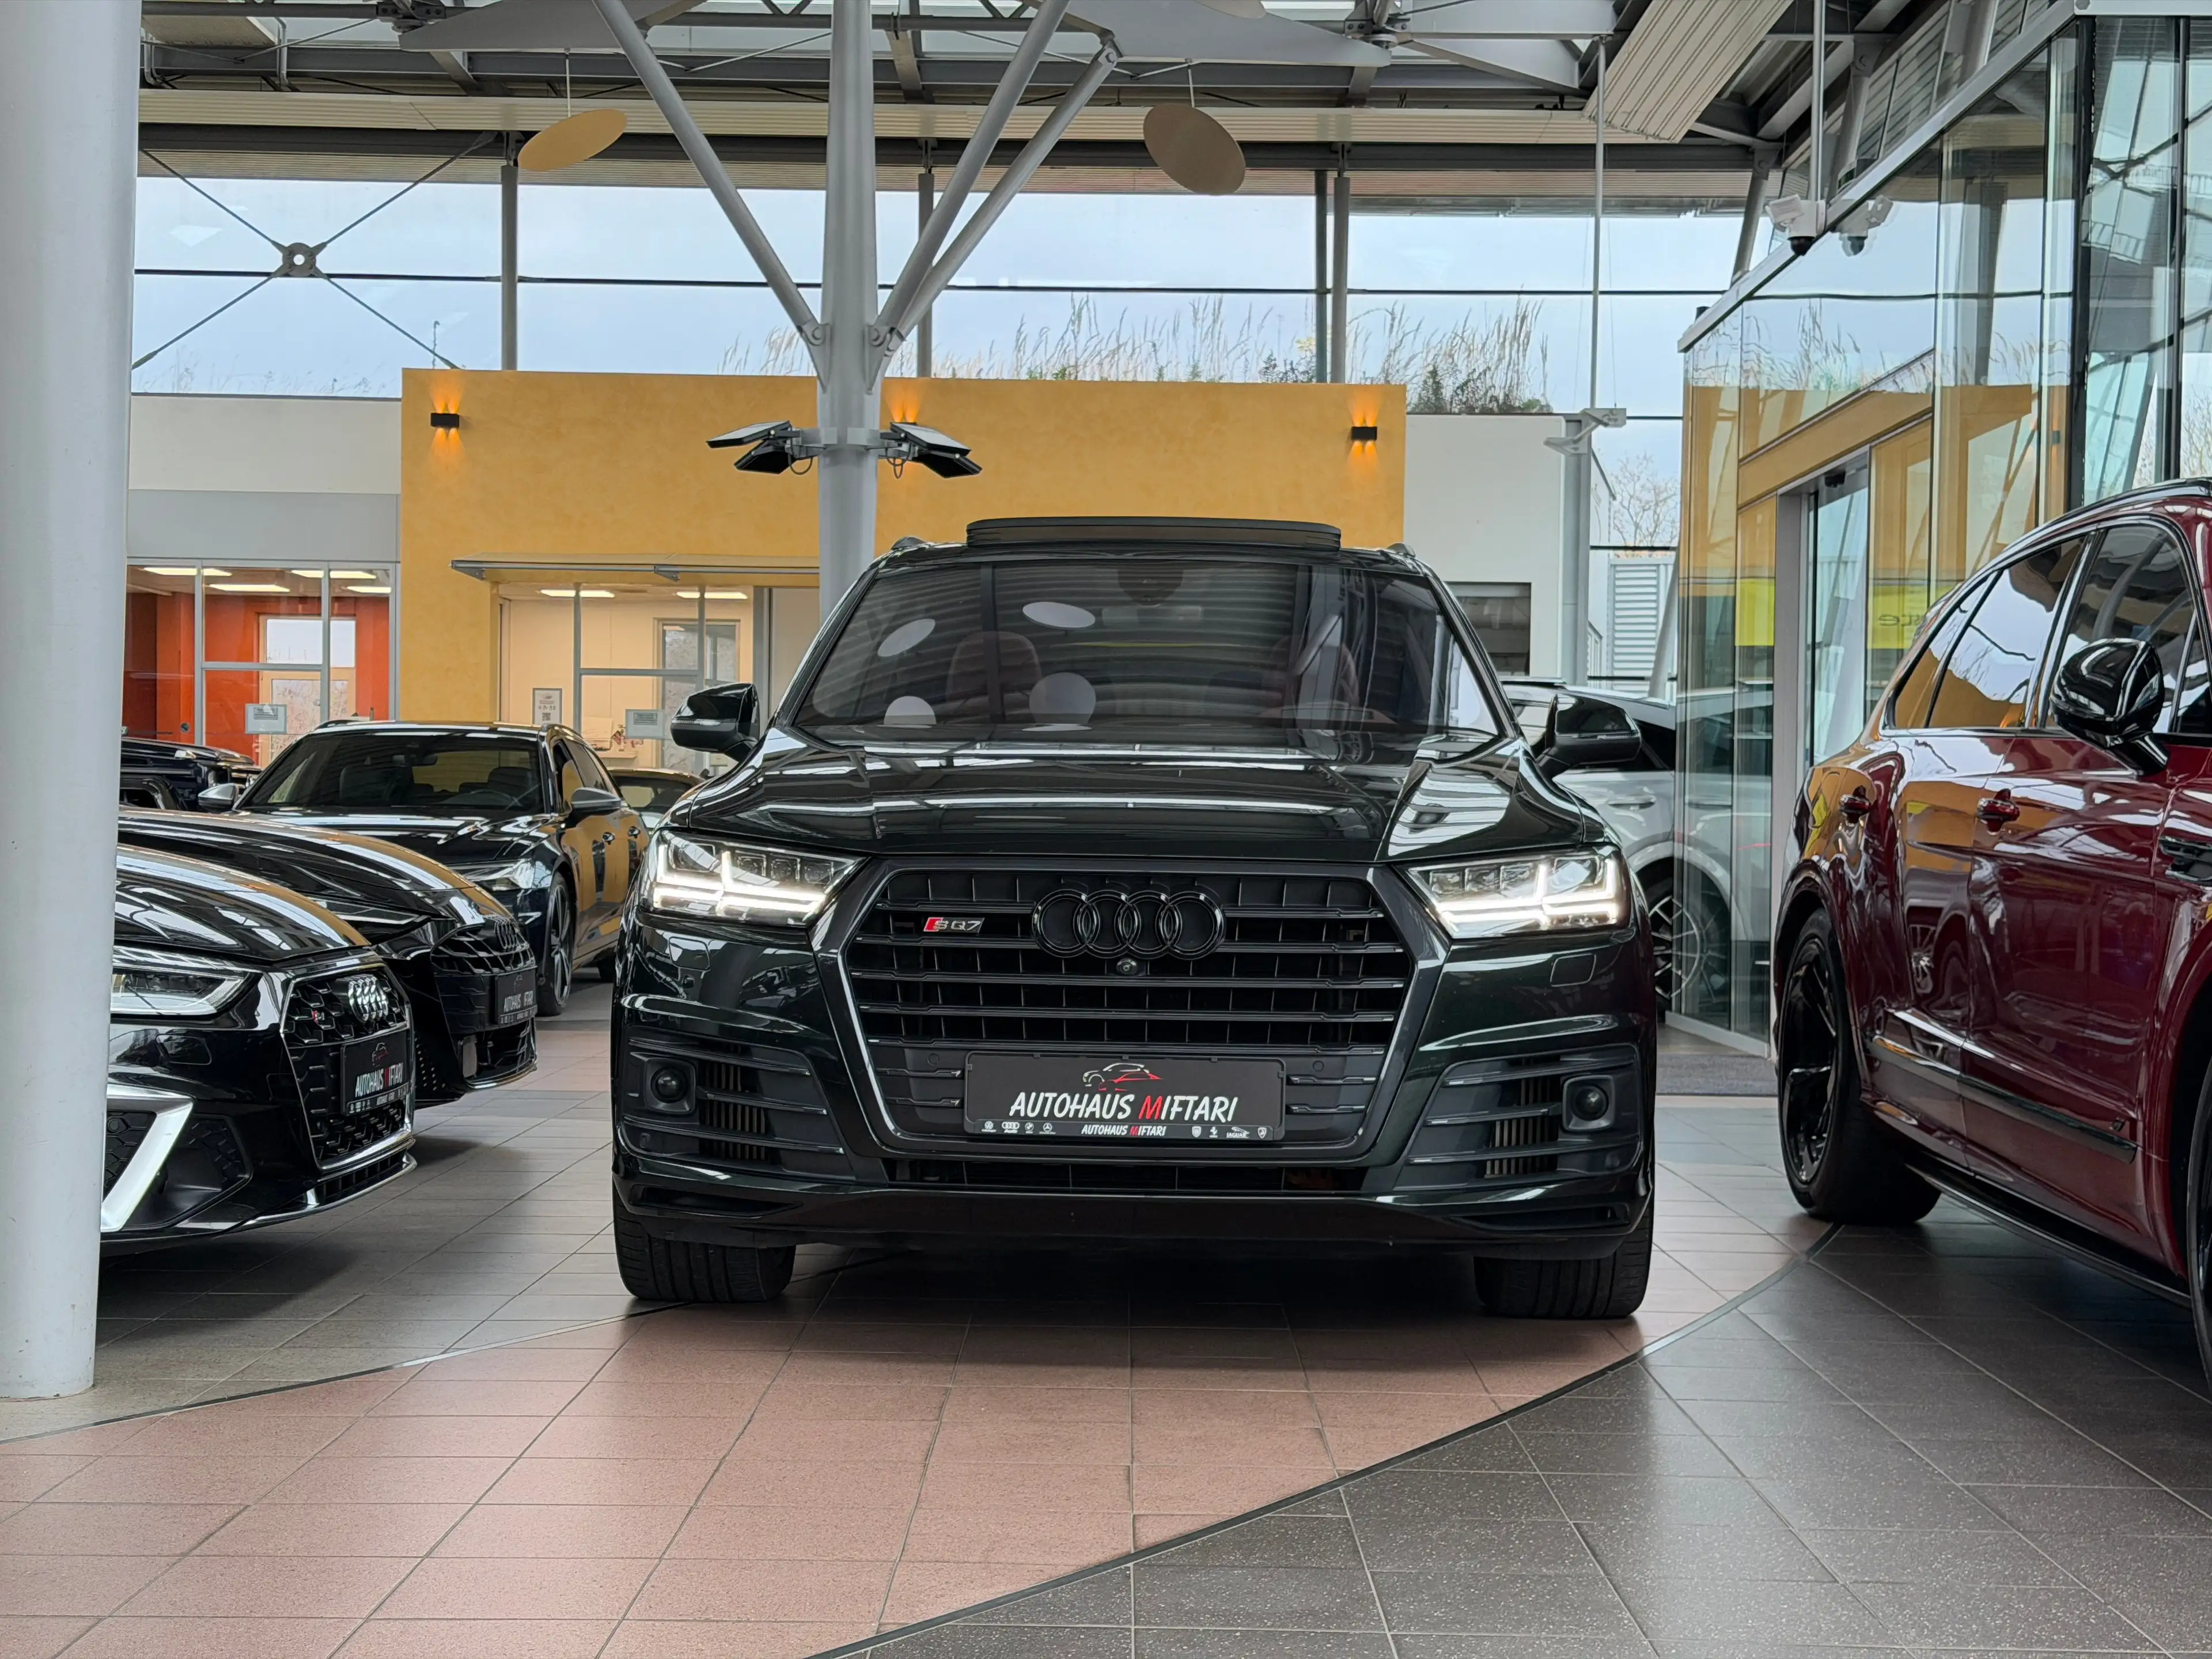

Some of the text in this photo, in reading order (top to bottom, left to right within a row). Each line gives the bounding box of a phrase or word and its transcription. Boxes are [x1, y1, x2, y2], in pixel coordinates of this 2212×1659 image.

[933, 920, 982, 931] SQ7
[355, 1068, 384, 1098] AUTOHAUS
[1009, 1091, 1238, 1123] AUTOHAUS MIFTARI
[1081, 1124, 1167, 1137] AUTOHAUS MIFTARI
